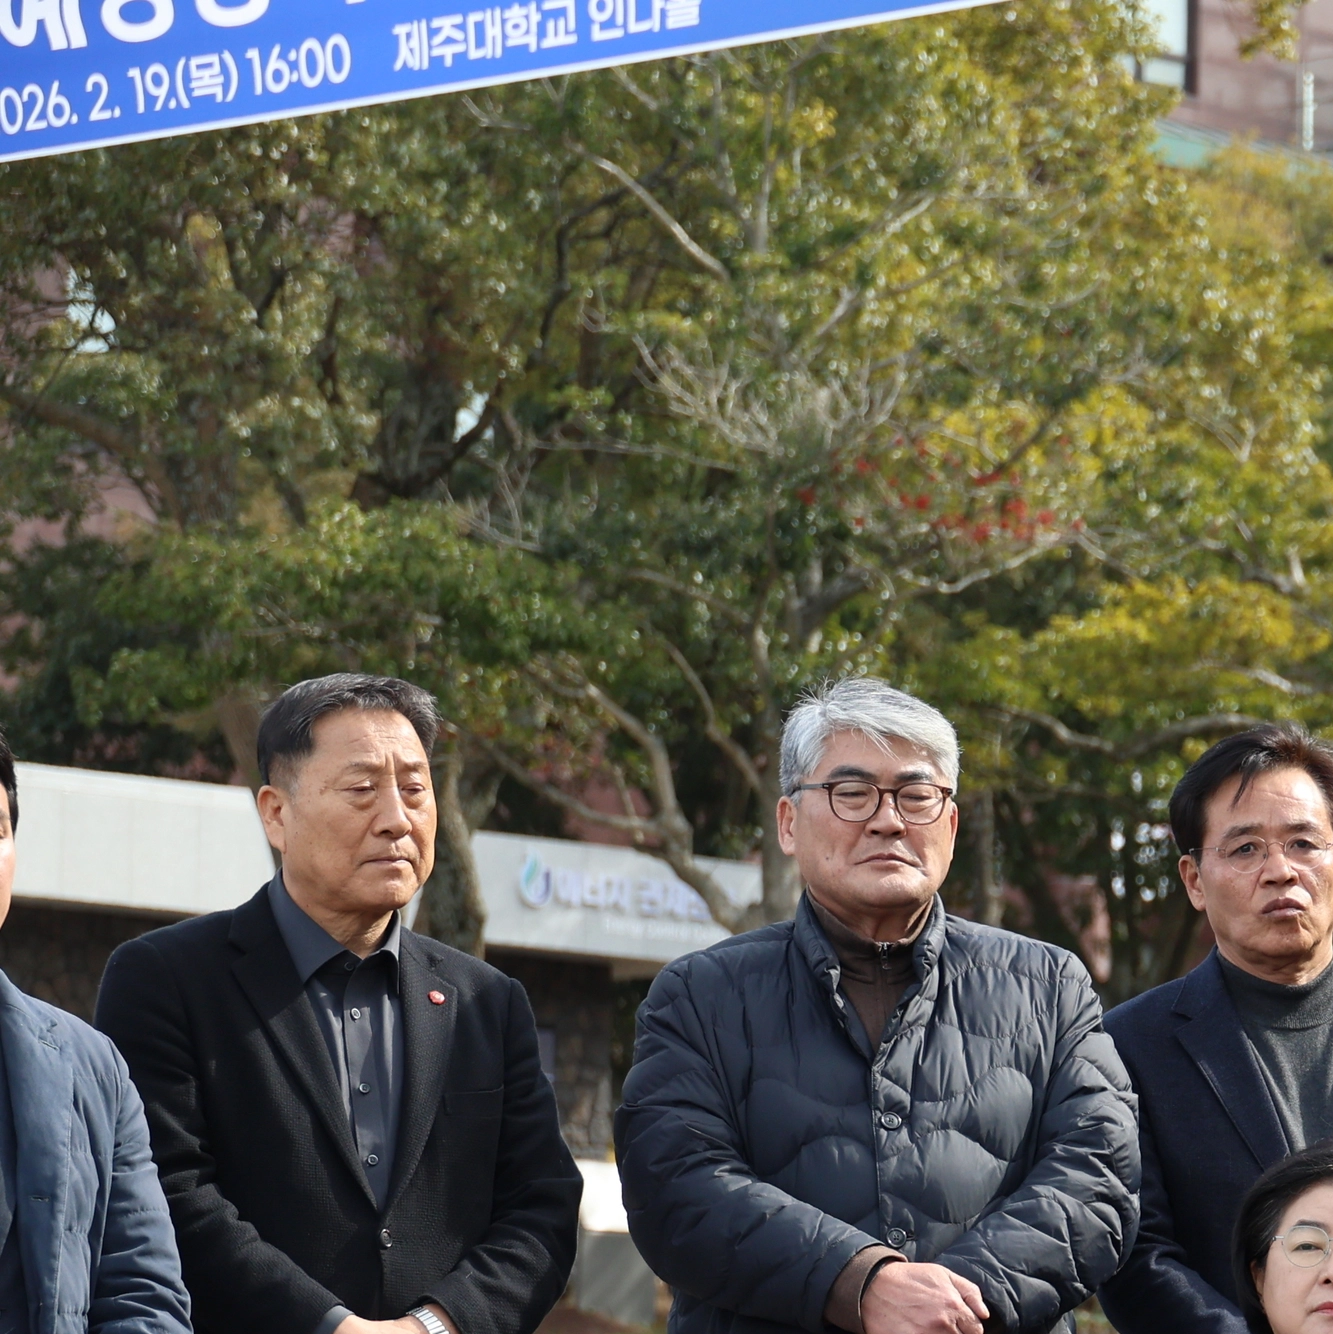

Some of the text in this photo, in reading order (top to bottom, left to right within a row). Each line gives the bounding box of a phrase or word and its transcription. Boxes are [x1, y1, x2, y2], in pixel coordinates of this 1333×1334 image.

[0, 80, 78, 135] 026.
[85, 72, 121, 122] 2.
[127, 50, 239, 114] 19.(목)
[245, 33, 351, 96] 16:00
[391, 0, 578, 72] 제주대학교
